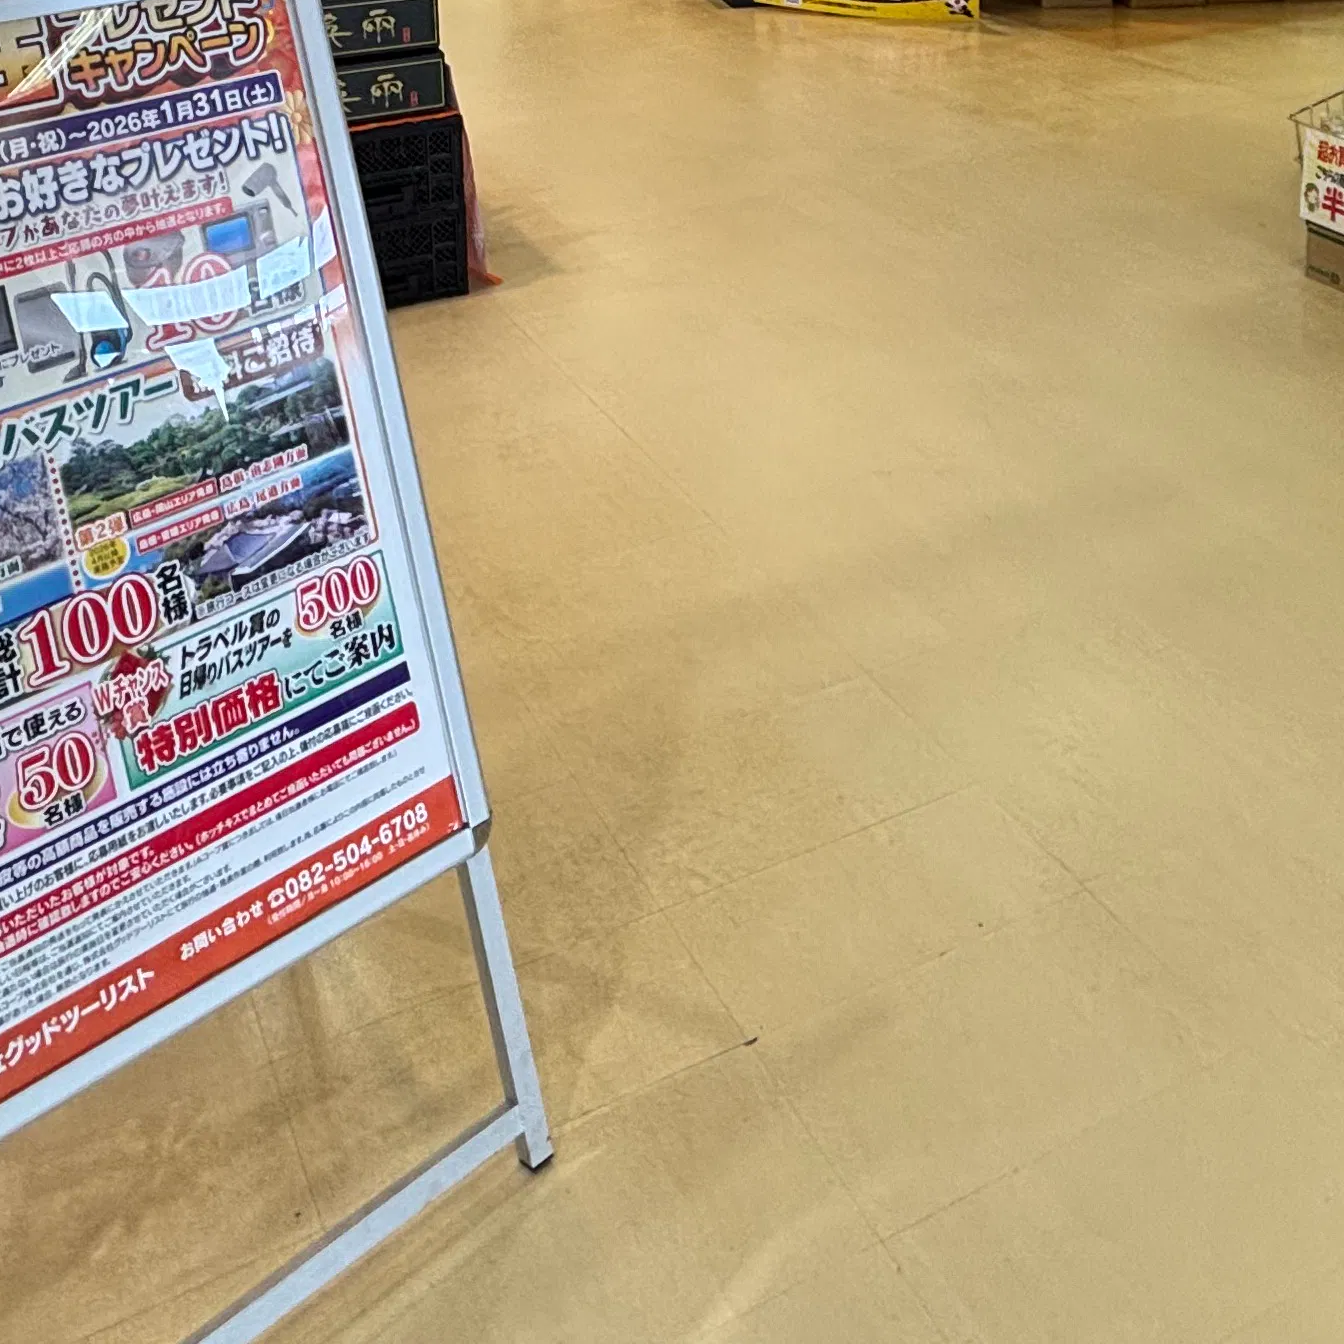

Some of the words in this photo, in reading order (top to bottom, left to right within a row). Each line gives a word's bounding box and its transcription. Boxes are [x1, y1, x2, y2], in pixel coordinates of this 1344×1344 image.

[65, 18, 264, 96] キャンペーン
[153, 559, 191, 626] 名様
[291, 551, 383, 635] 500
[329, 609, 363, 640] 名様
[16, 566, 162, 695] 100
[177, 626, 295, 700] 日帰りバスツアーを
[178, 603, 282, 671] トラベル賞の
[92, 656, 169, 718] Wチャンス
[121, 695, 152, 733] 賞
[11, 725, 99, 816] 50
[41, 791, 85, 829] 名様
[179, 897, 264, 961] お問い合わせ
[283, 800, 428, 900] 082-504-6708
